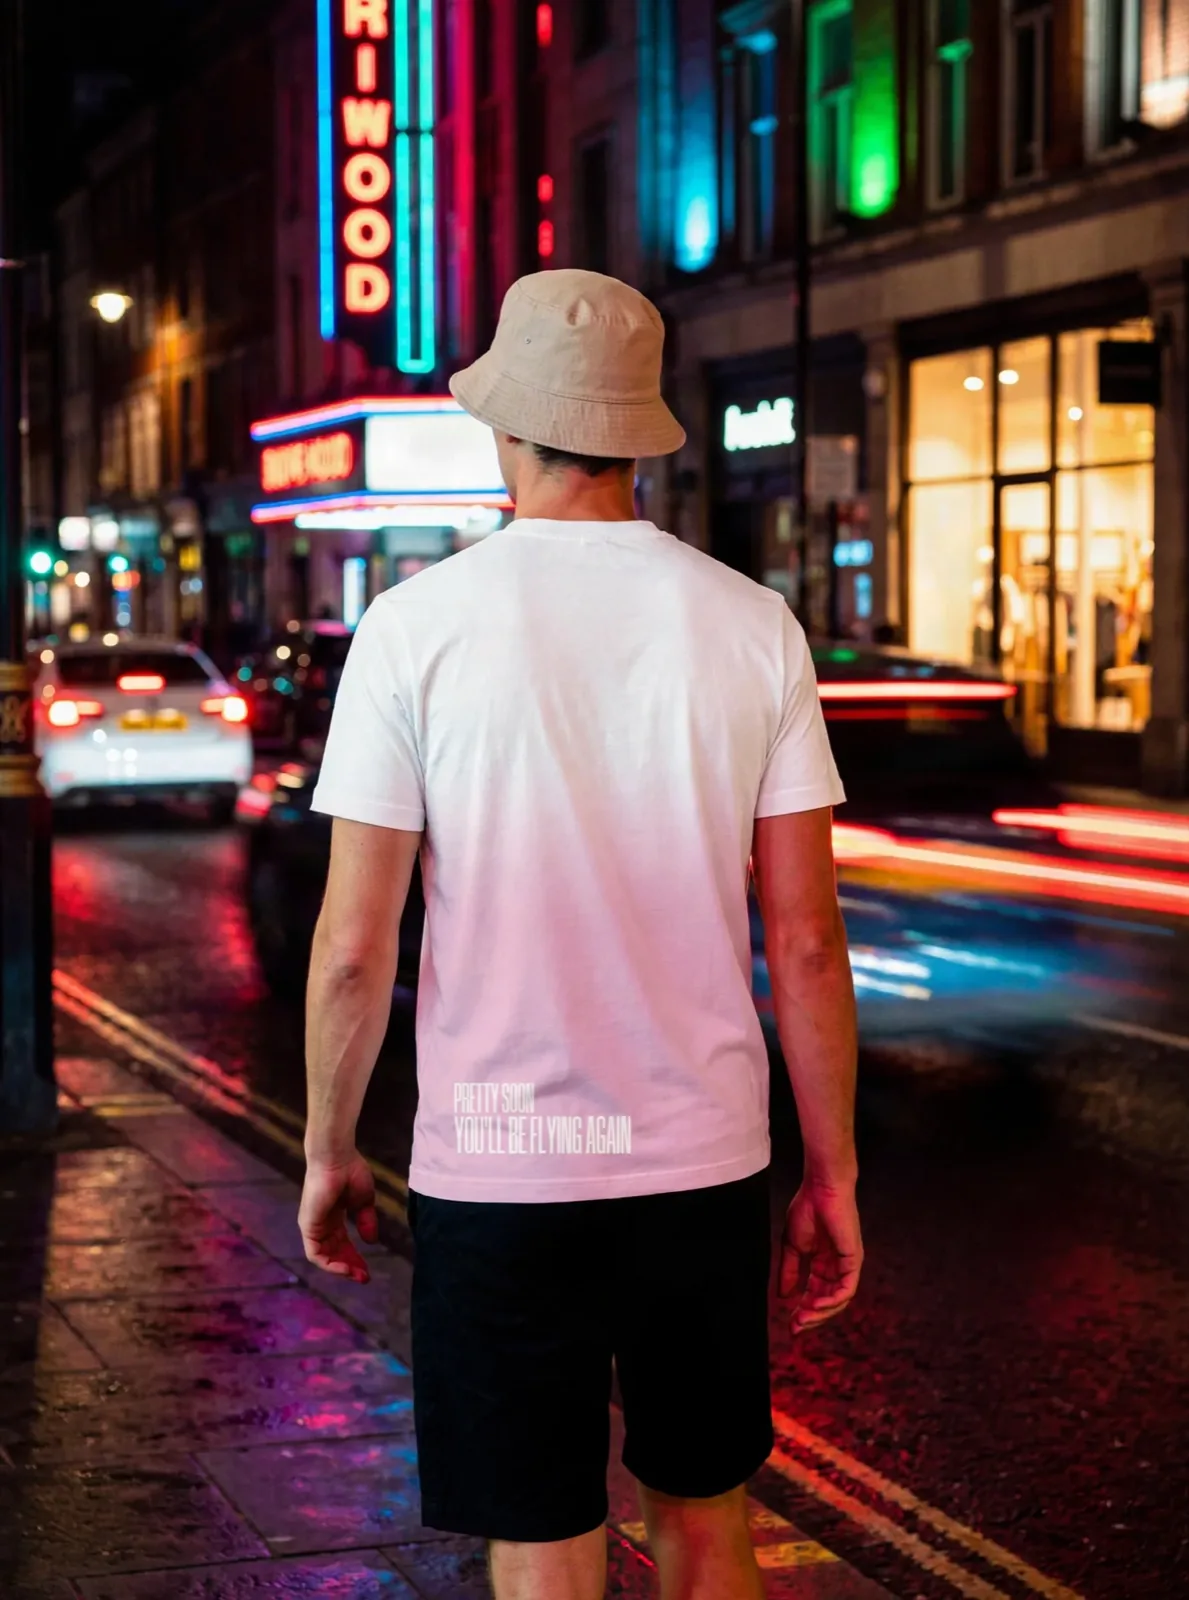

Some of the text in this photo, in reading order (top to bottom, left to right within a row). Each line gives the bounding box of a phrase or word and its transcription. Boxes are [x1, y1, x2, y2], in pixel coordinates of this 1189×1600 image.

[453, 1082, 535, 1113] PRETTY SOON
[454, 1115, 632, 1154] YOU'LL BE FLYING AGAIN
